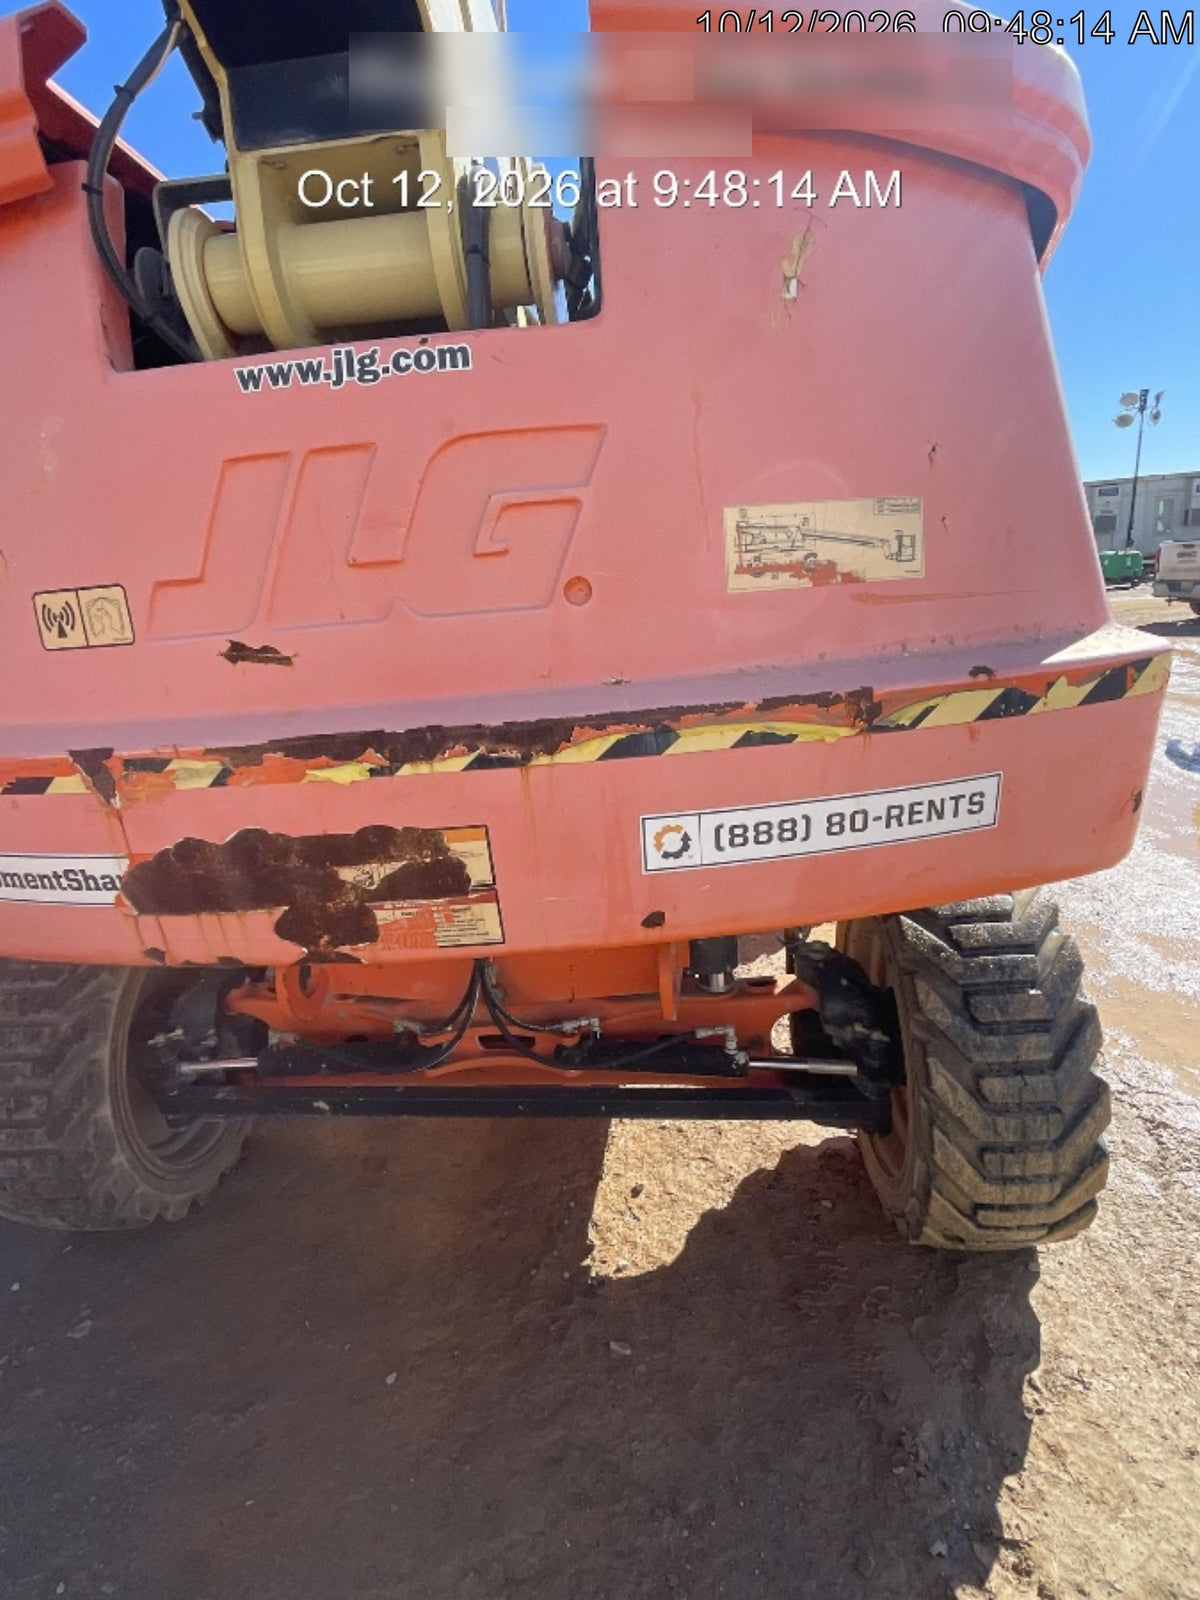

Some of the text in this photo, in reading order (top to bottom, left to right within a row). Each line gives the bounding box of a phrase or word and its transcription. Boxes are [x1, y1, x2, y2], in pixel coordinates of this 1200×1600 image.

[234, 344, 472, 393] www.jlg.com
[714, 791, 986, 852] (888) 80-RENTS
